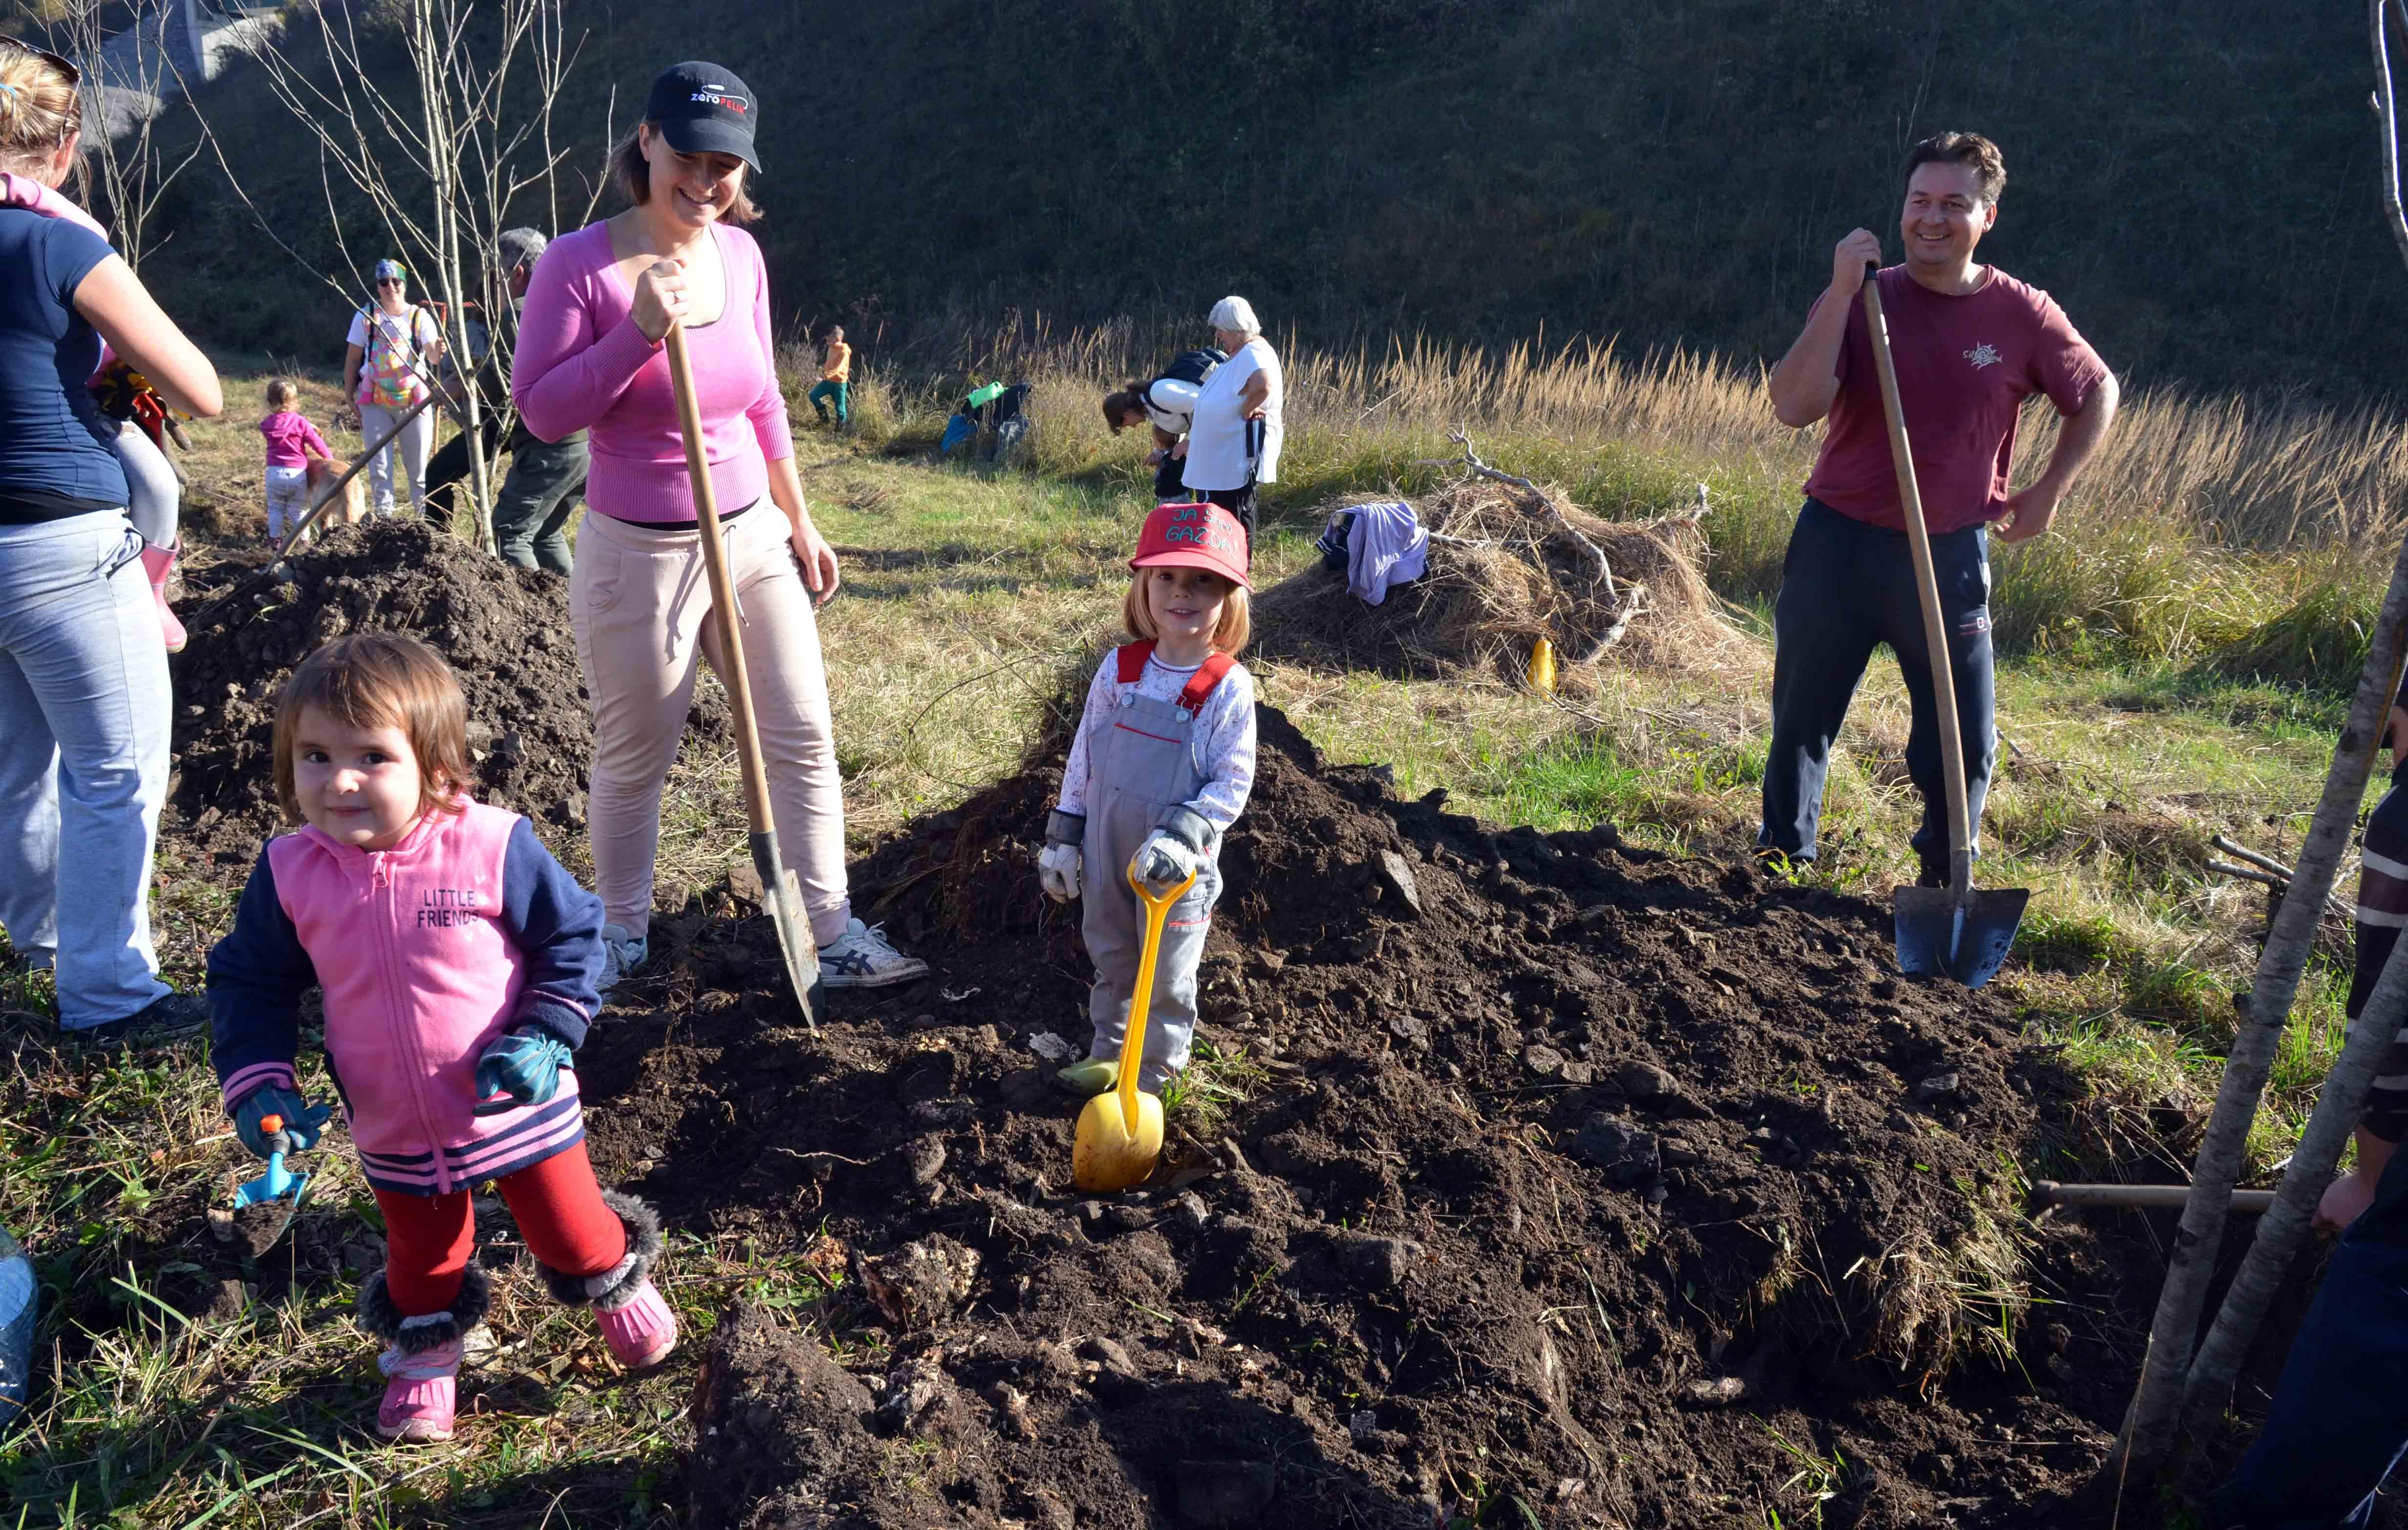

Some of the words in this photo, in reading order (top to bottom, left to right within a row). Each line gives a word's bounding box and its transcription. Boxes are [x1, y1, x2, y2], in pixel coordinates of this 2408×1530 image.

[1172, 508, 1197, 521] JA
[424, 889, 475, 907] LITTLE
[417, 909, 480, 928] FRIENDS
